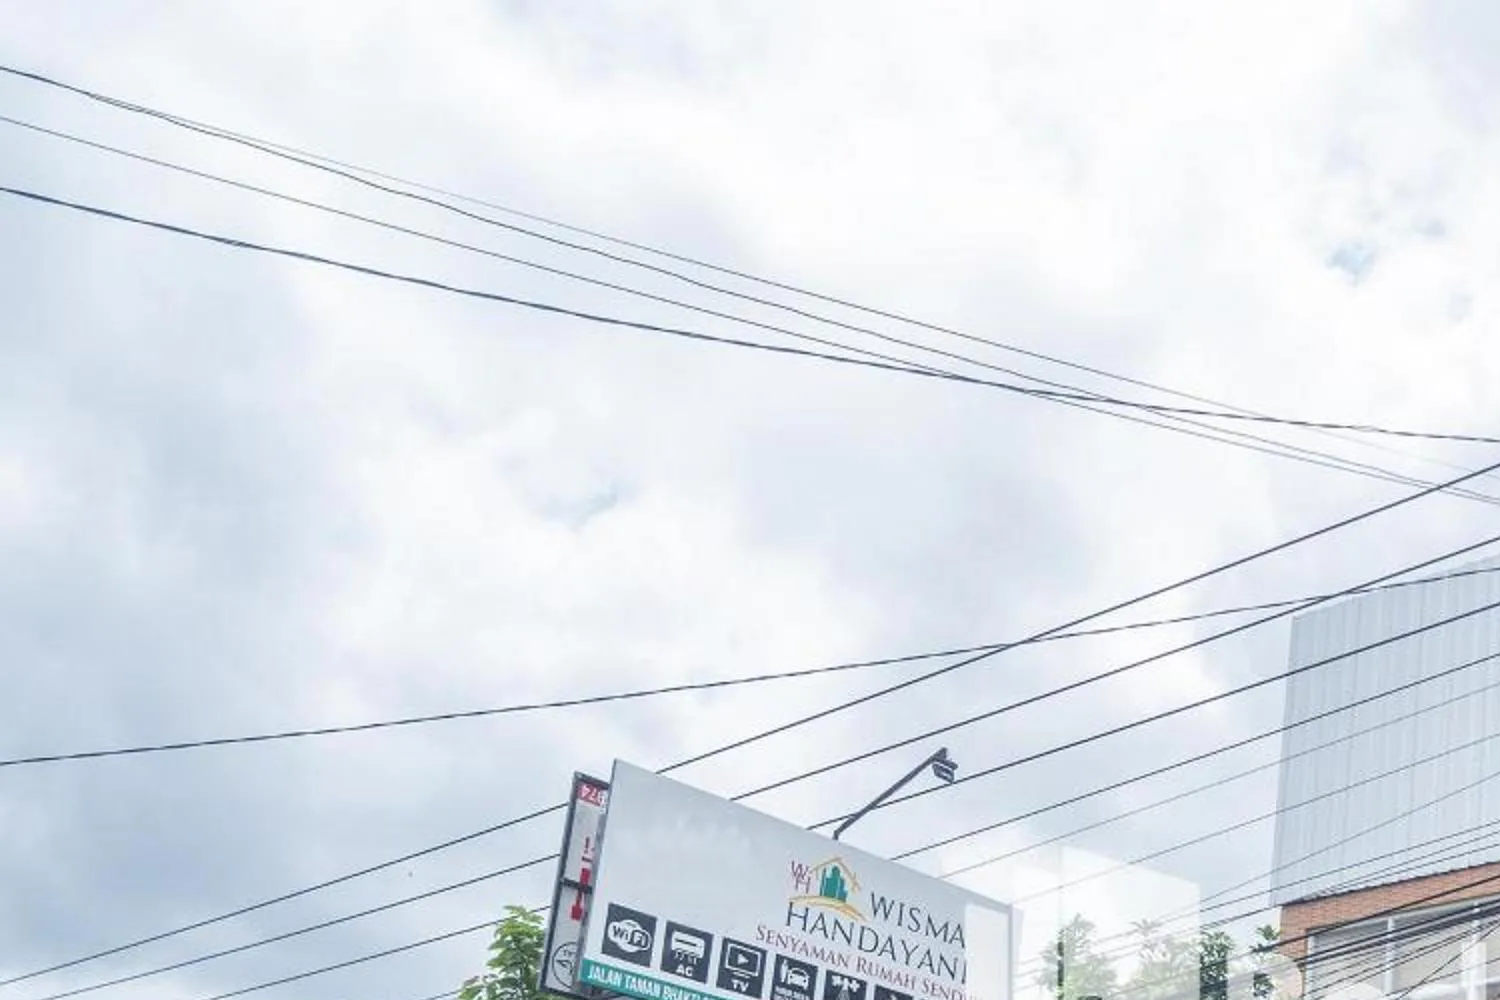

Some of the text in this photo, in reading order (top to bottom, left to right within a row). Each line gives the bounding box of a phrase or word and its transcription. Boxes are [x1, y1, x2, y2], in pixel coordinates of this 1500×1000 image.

[871, 892, 965, 949] WISMA
[786, 902, 967, 984] HANDAYANI
[587, 965, 620, 986] JALAN
[624, 974, 661, 998] TAMAN
[676, 964, 693, 977] AC
[731, 980, 750, 992] TV
[856, 956, 914, 990] RUMAH
